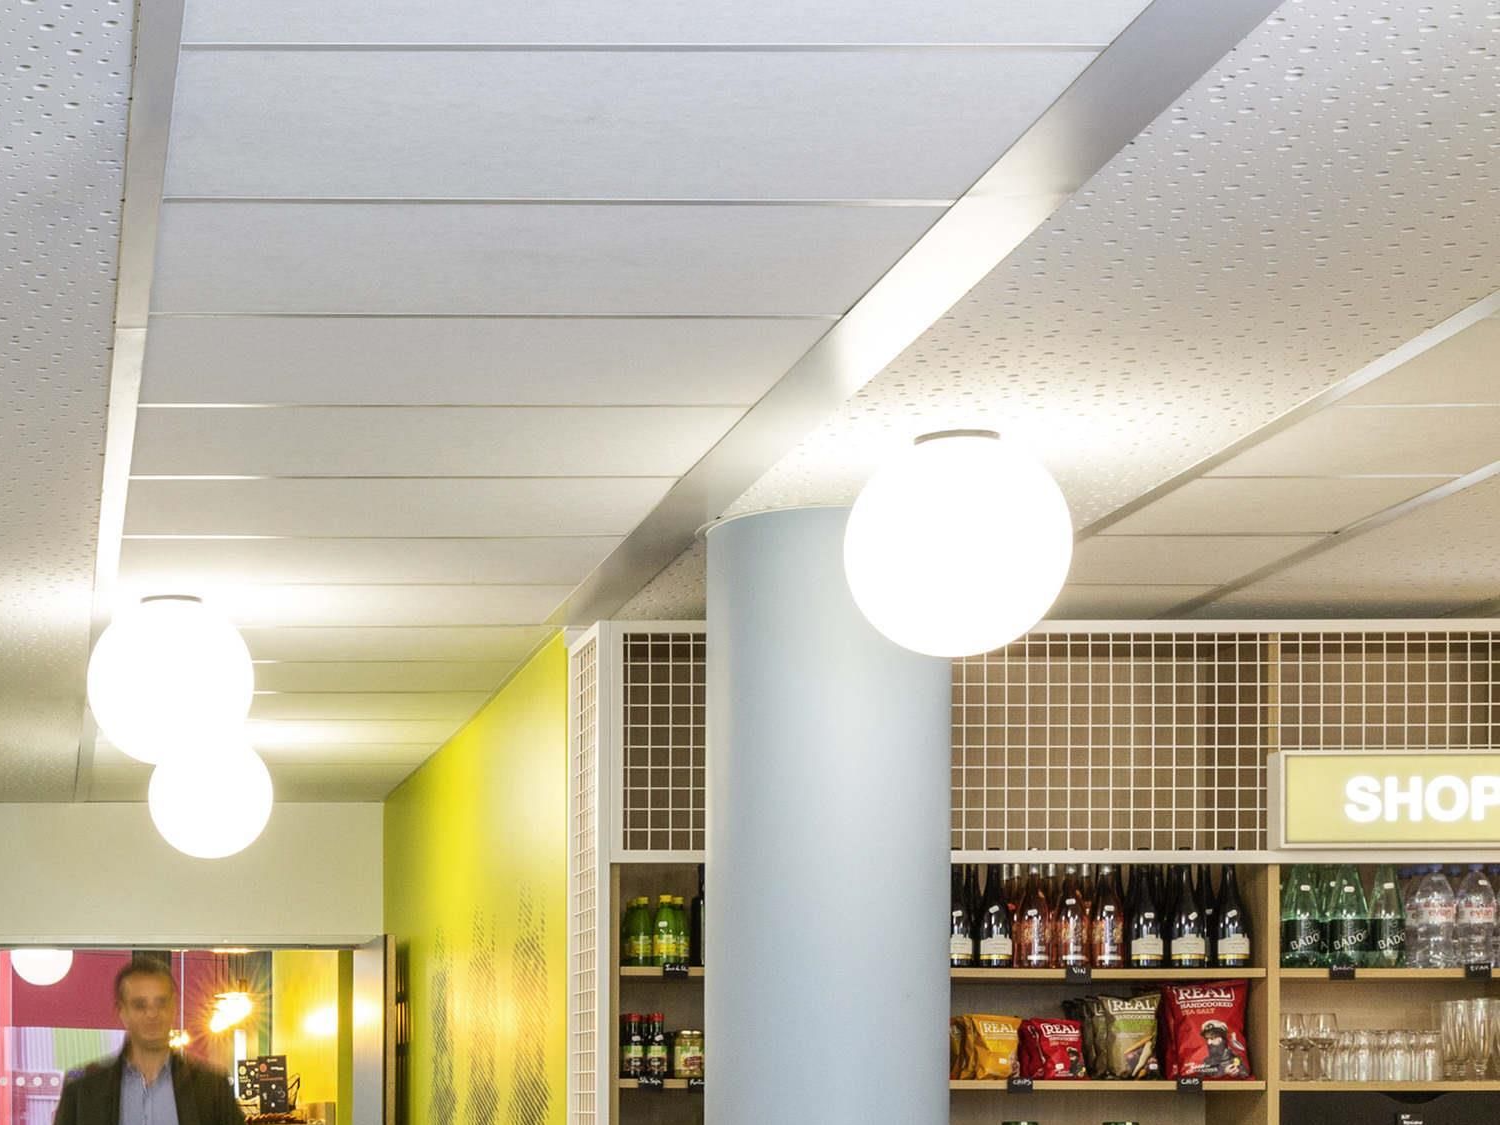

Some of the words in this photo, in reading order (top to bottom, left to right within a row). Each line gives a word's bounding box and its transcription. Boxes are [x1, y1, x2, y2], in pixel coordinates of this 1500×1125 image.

[1344, 774, 1500, 823] SHOP
[1179, 987, 1231, 1000] REAL
[1112, 1000, 1156, 1011] REAL
[1181, 1001, 1233, 1009] HANDCOOKED
[984, 1023, 1018, 1033] REAL
[1044, 1024, 1080, 1034] REAL
